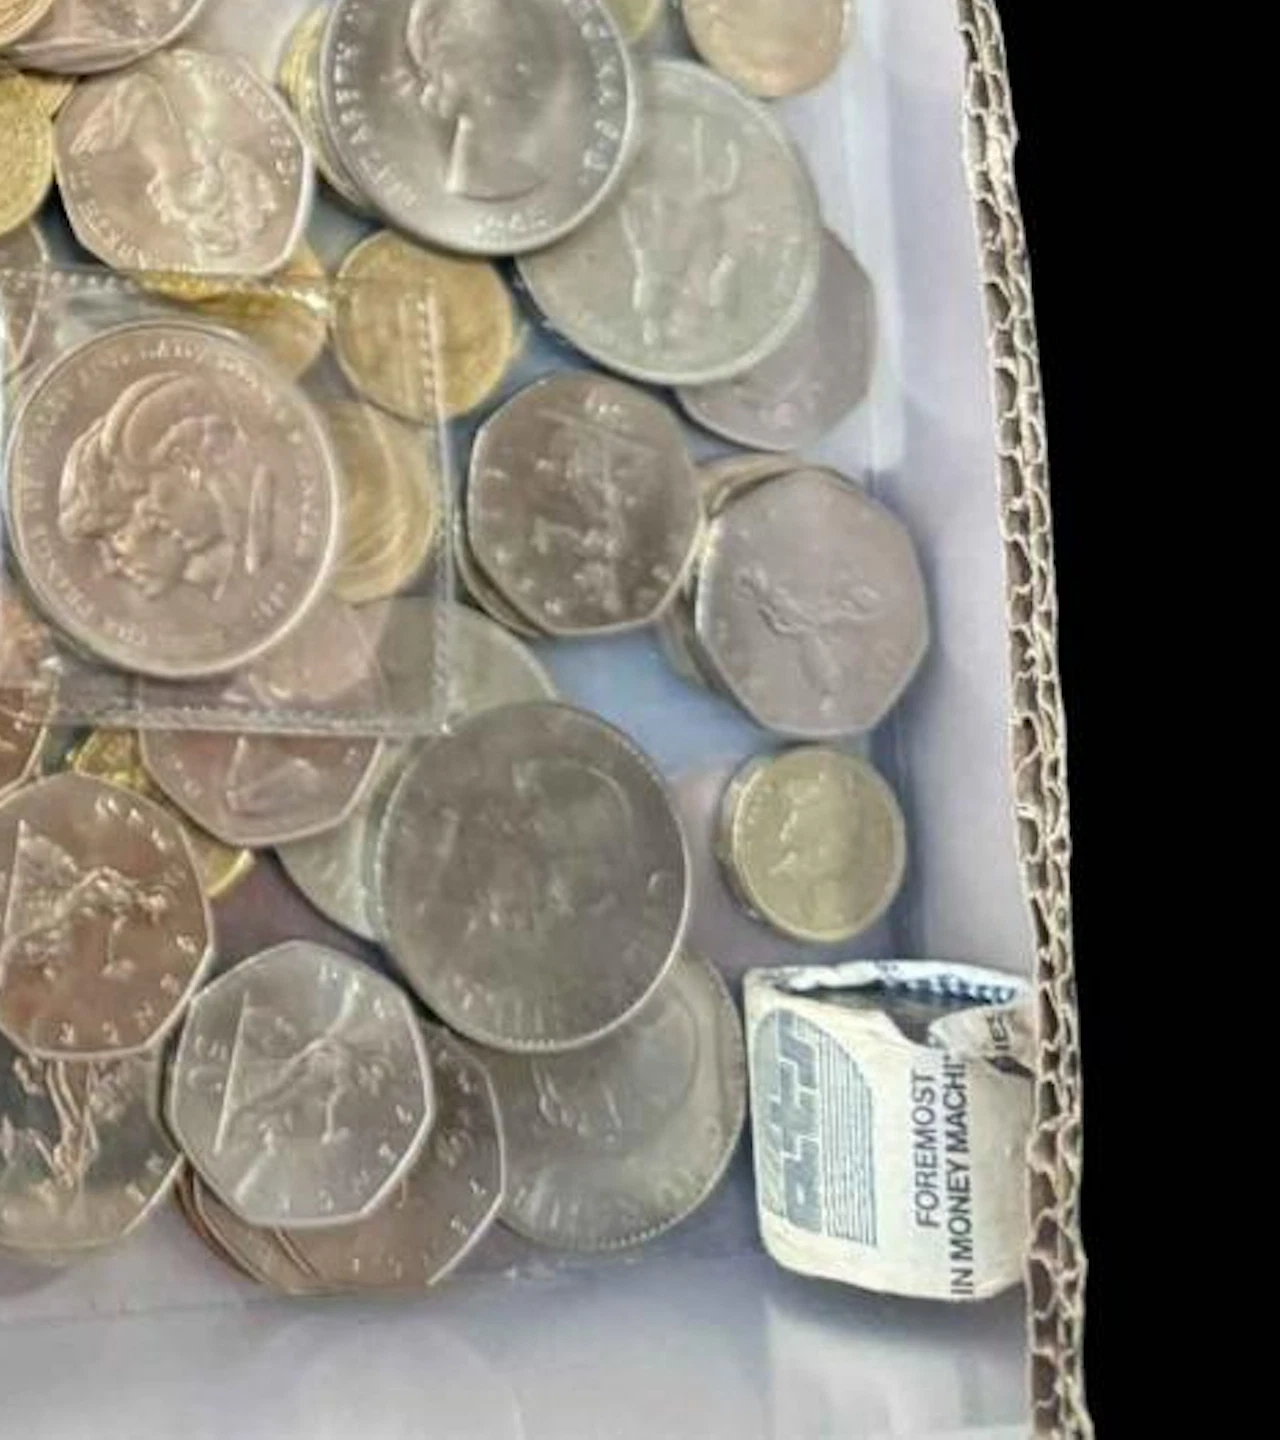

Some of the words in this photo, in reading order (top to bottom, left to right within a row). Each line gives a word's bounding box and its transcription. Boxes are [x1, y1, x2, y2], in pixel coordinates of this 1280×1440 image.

[910, 1069, 940, 1229] FOREMOST
[942, 1053, 971, 1154] MACHI
[946, 1155, 974, 1268] MONEY
[950, 1268, 975, 1297] IN
